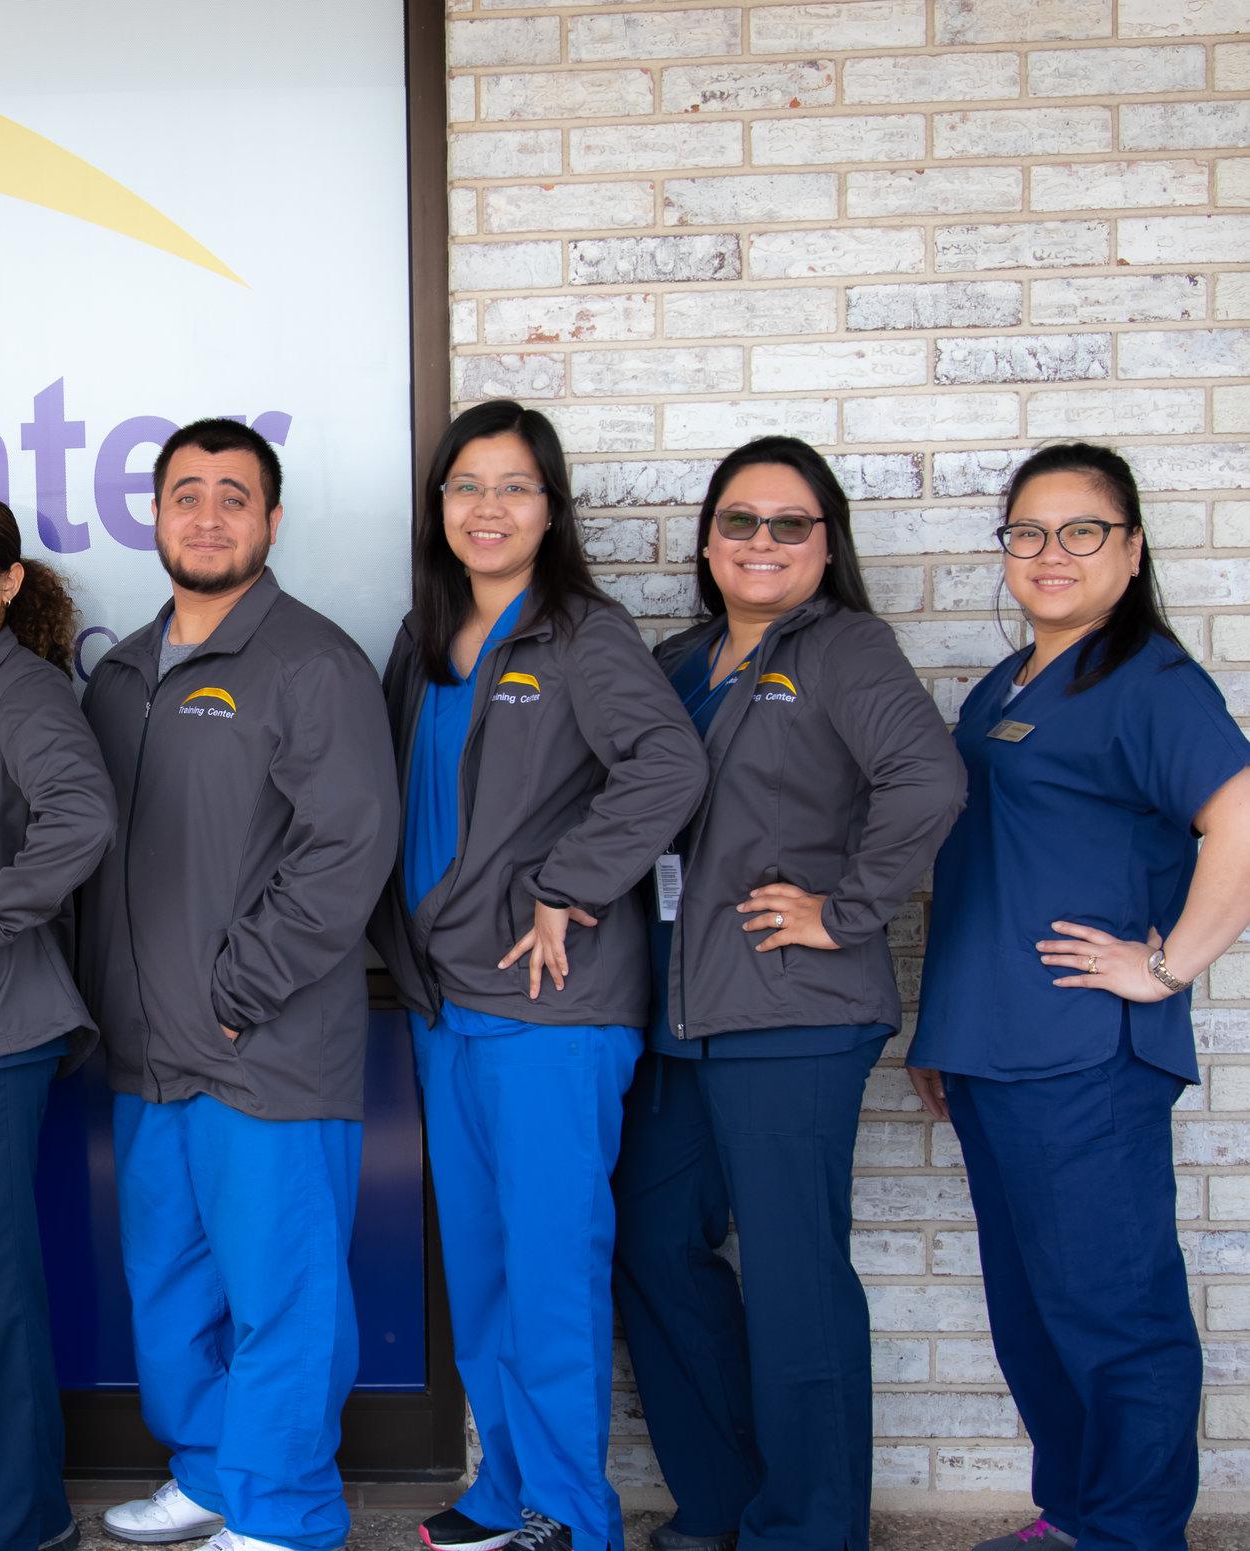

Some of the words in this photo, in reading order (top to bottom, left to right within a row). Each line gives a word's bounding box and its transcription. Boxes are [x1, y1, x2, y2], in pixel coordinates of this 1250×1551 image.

[766, 692, 797, 703] Center
[179, 705, 205, 716] Training
[208, 707, 235, 719] Center
